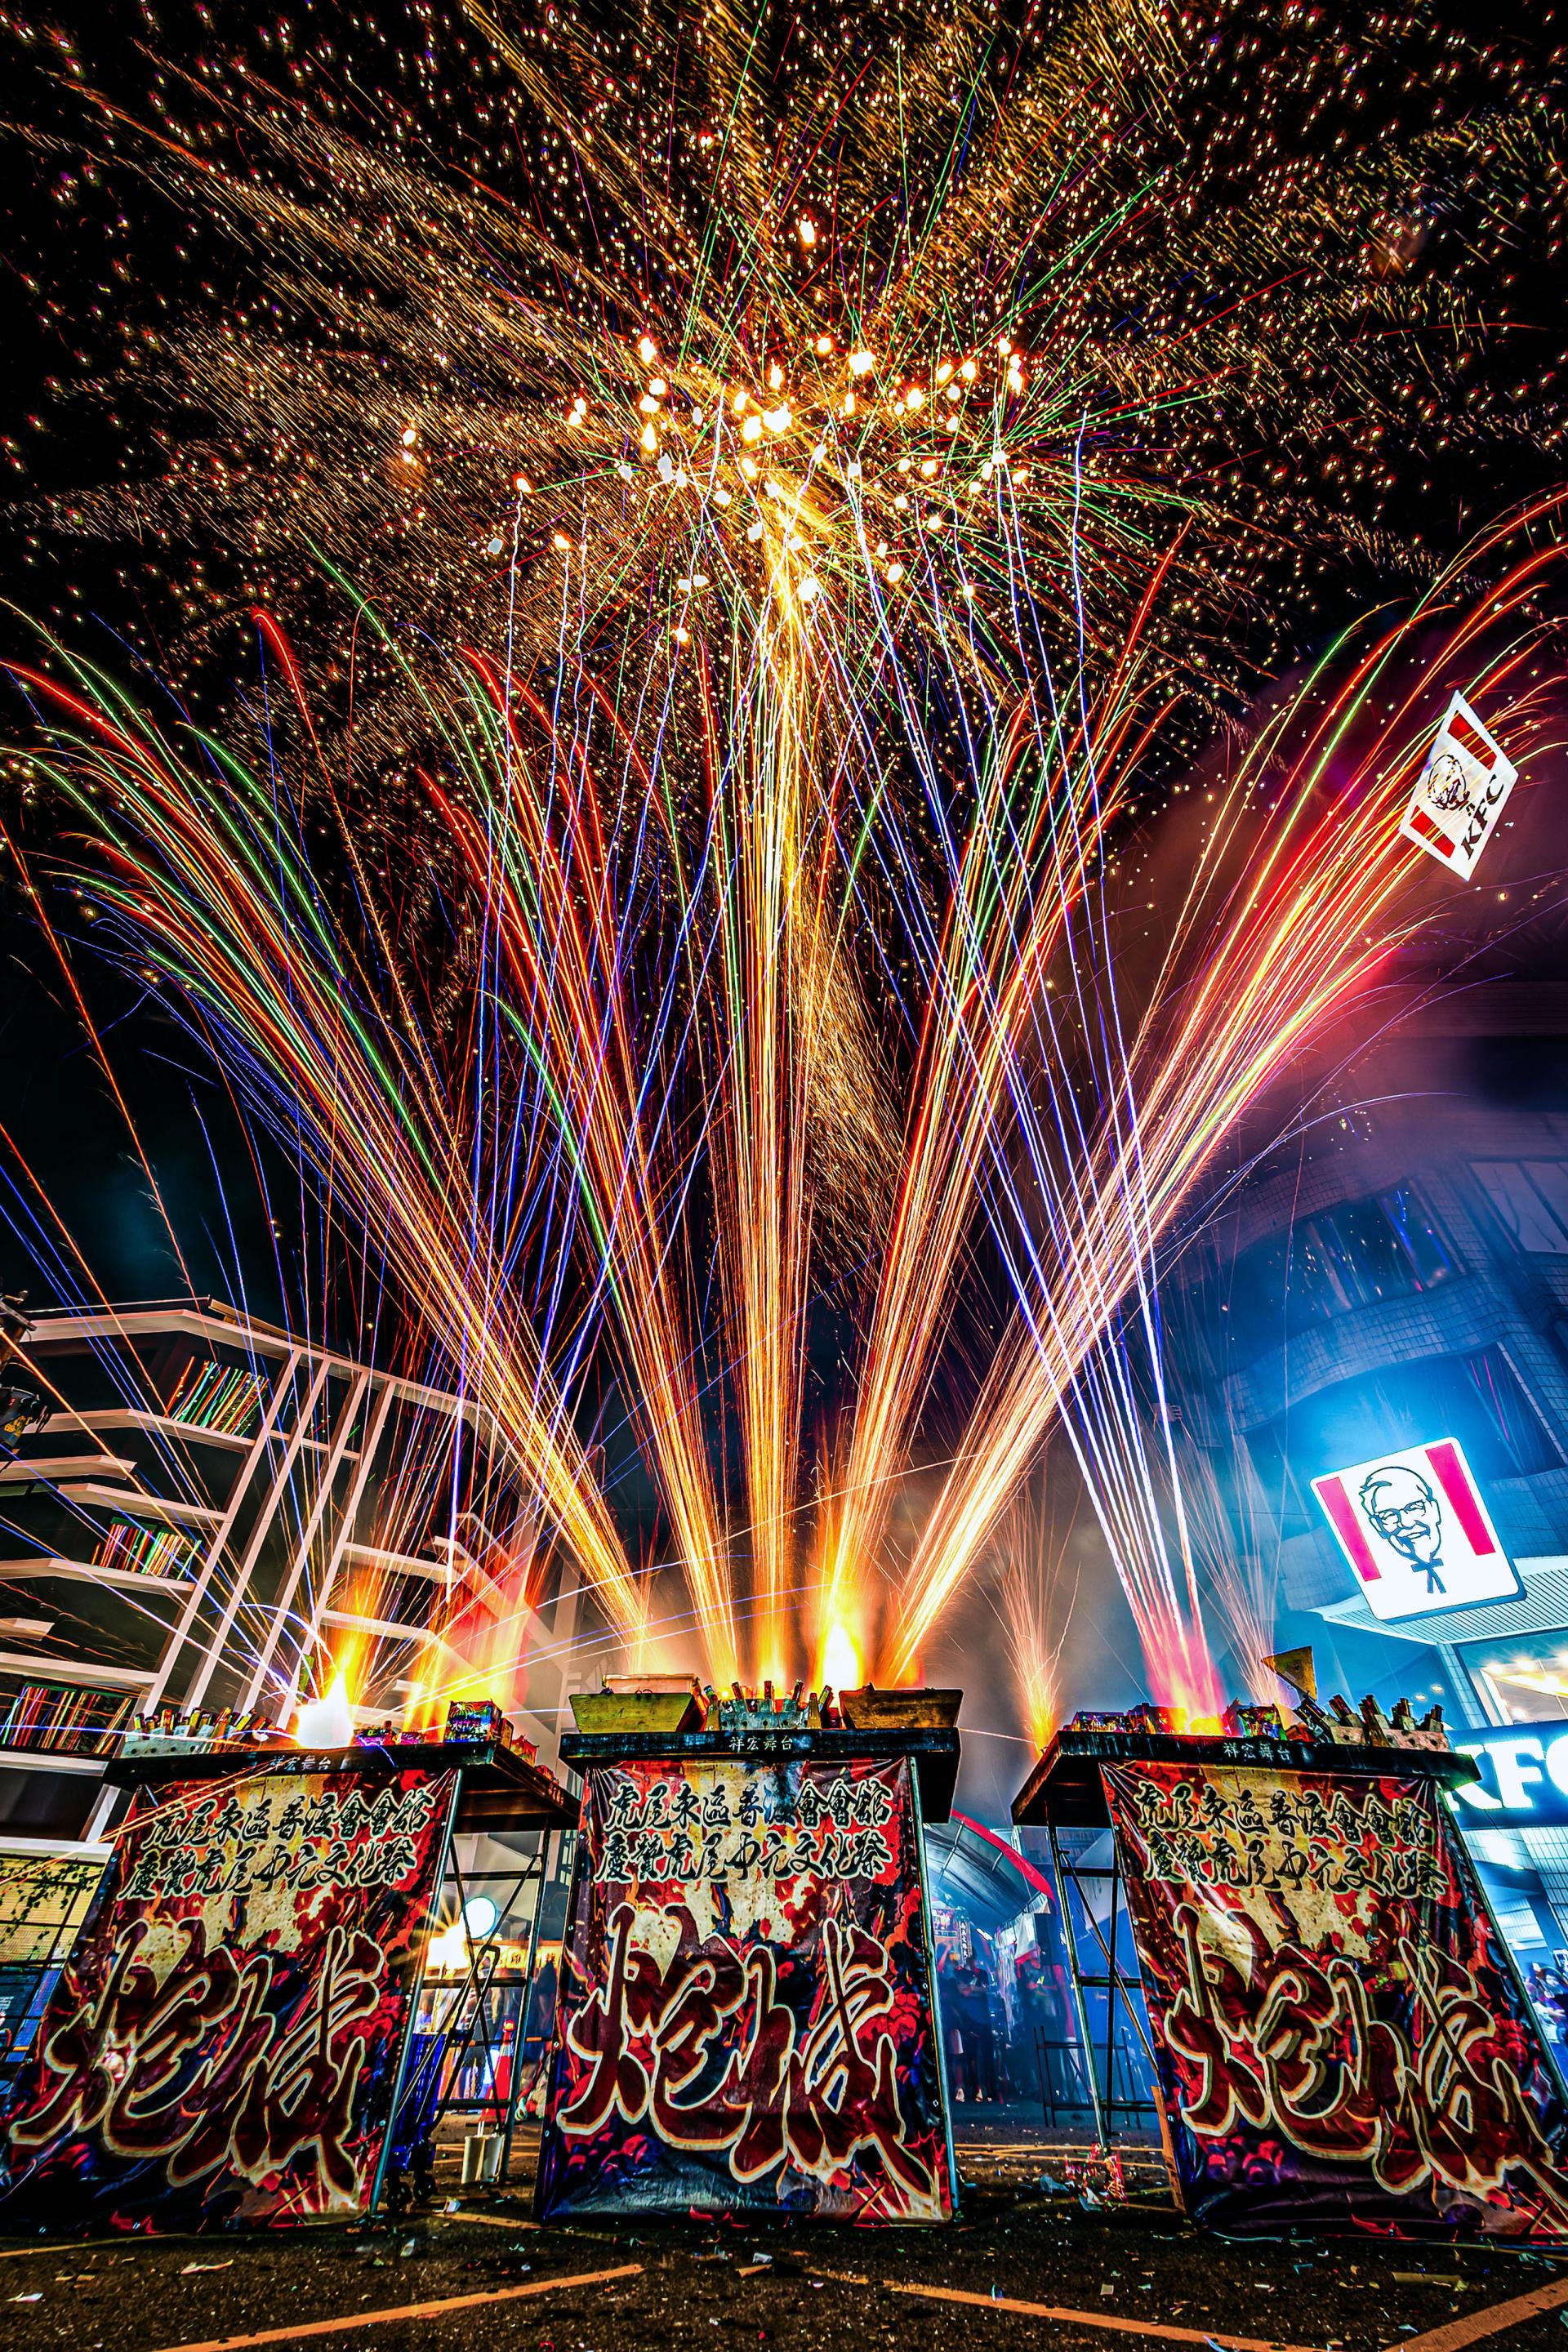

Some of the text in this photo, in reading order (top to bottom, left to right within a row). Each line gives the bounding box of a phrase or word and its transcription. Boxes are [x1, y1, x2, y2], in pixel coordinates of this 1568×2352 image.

[1461, 774, 1504, 860] KFC
[140, 1788, 436, 1851] 虎尾東區普渡會會館
[604, 1778, 894, 1833] 虎尾東區普渡會會館
[1133, 1781, 1437, 1848] 虎尾東區普渡會會館
